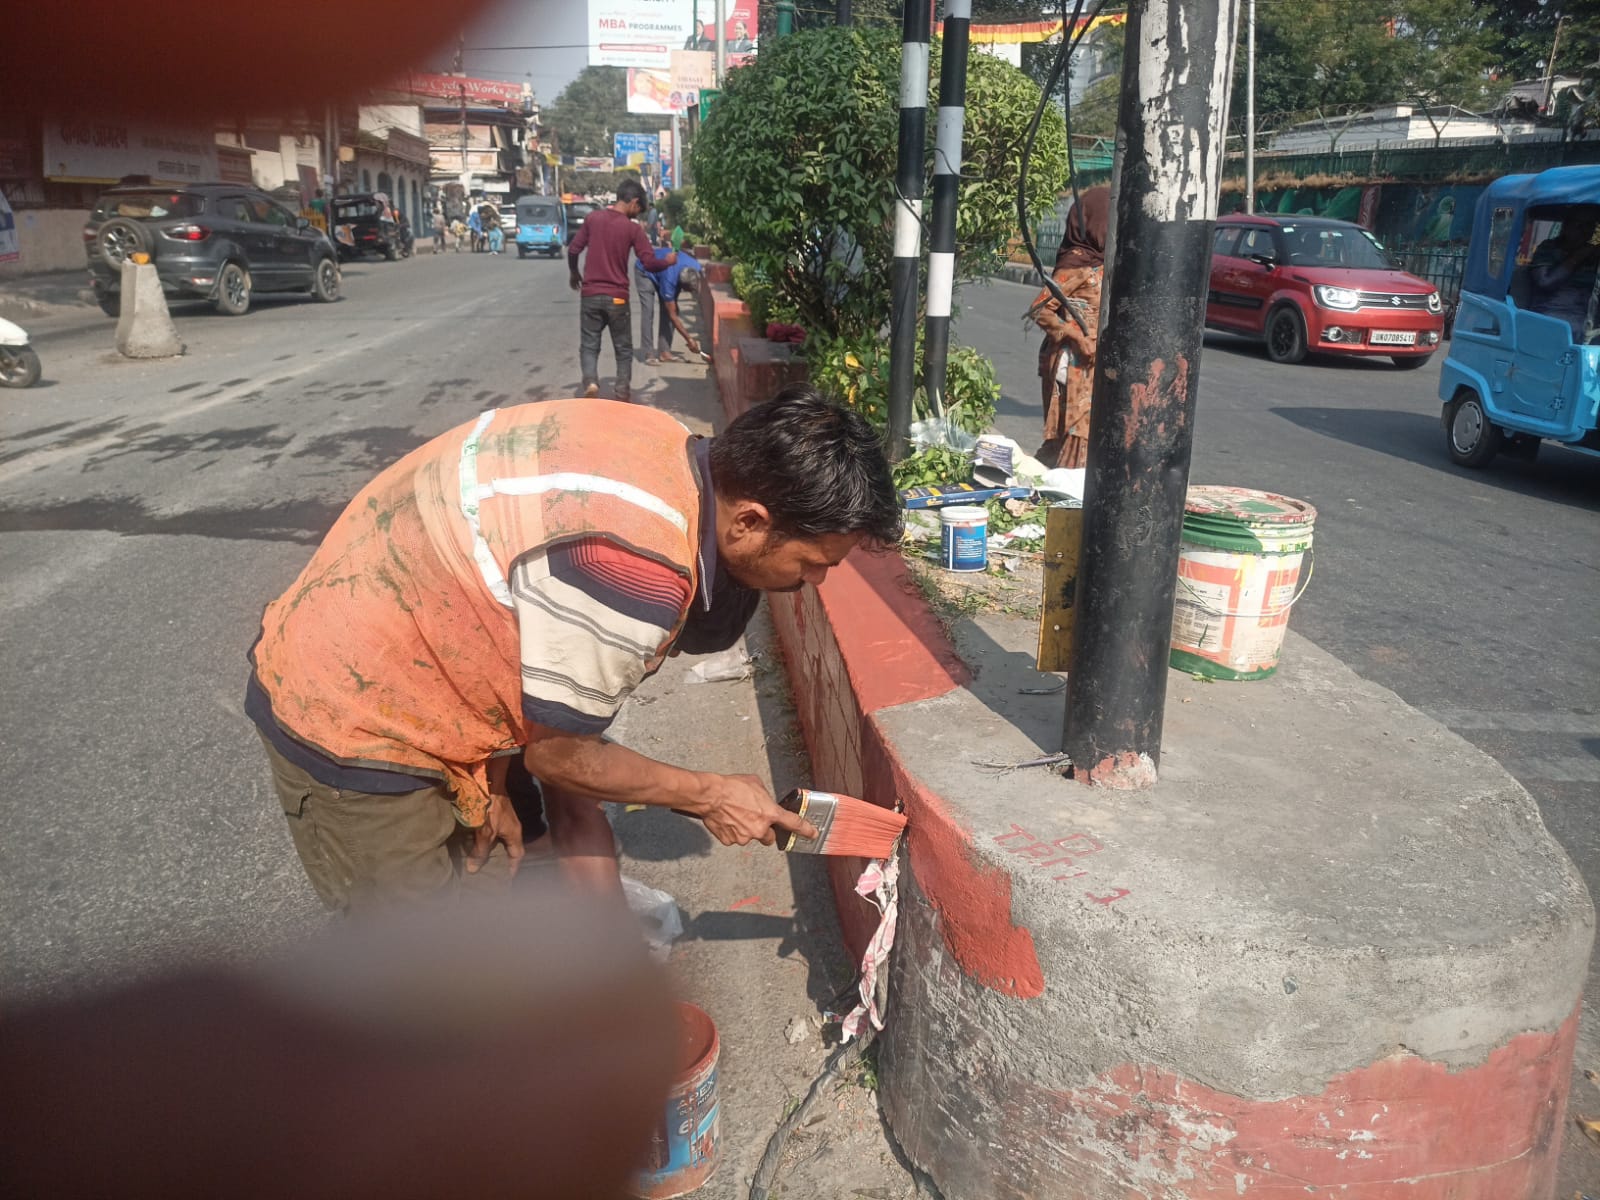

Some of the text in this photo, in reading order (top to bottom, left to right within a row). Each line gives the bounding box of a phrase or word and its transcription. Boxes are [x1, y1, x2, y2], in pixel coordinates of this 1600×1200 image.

[599, 18, 683, 32] MBA PROGRAMMES
[467, 81, 504, 95] Works
